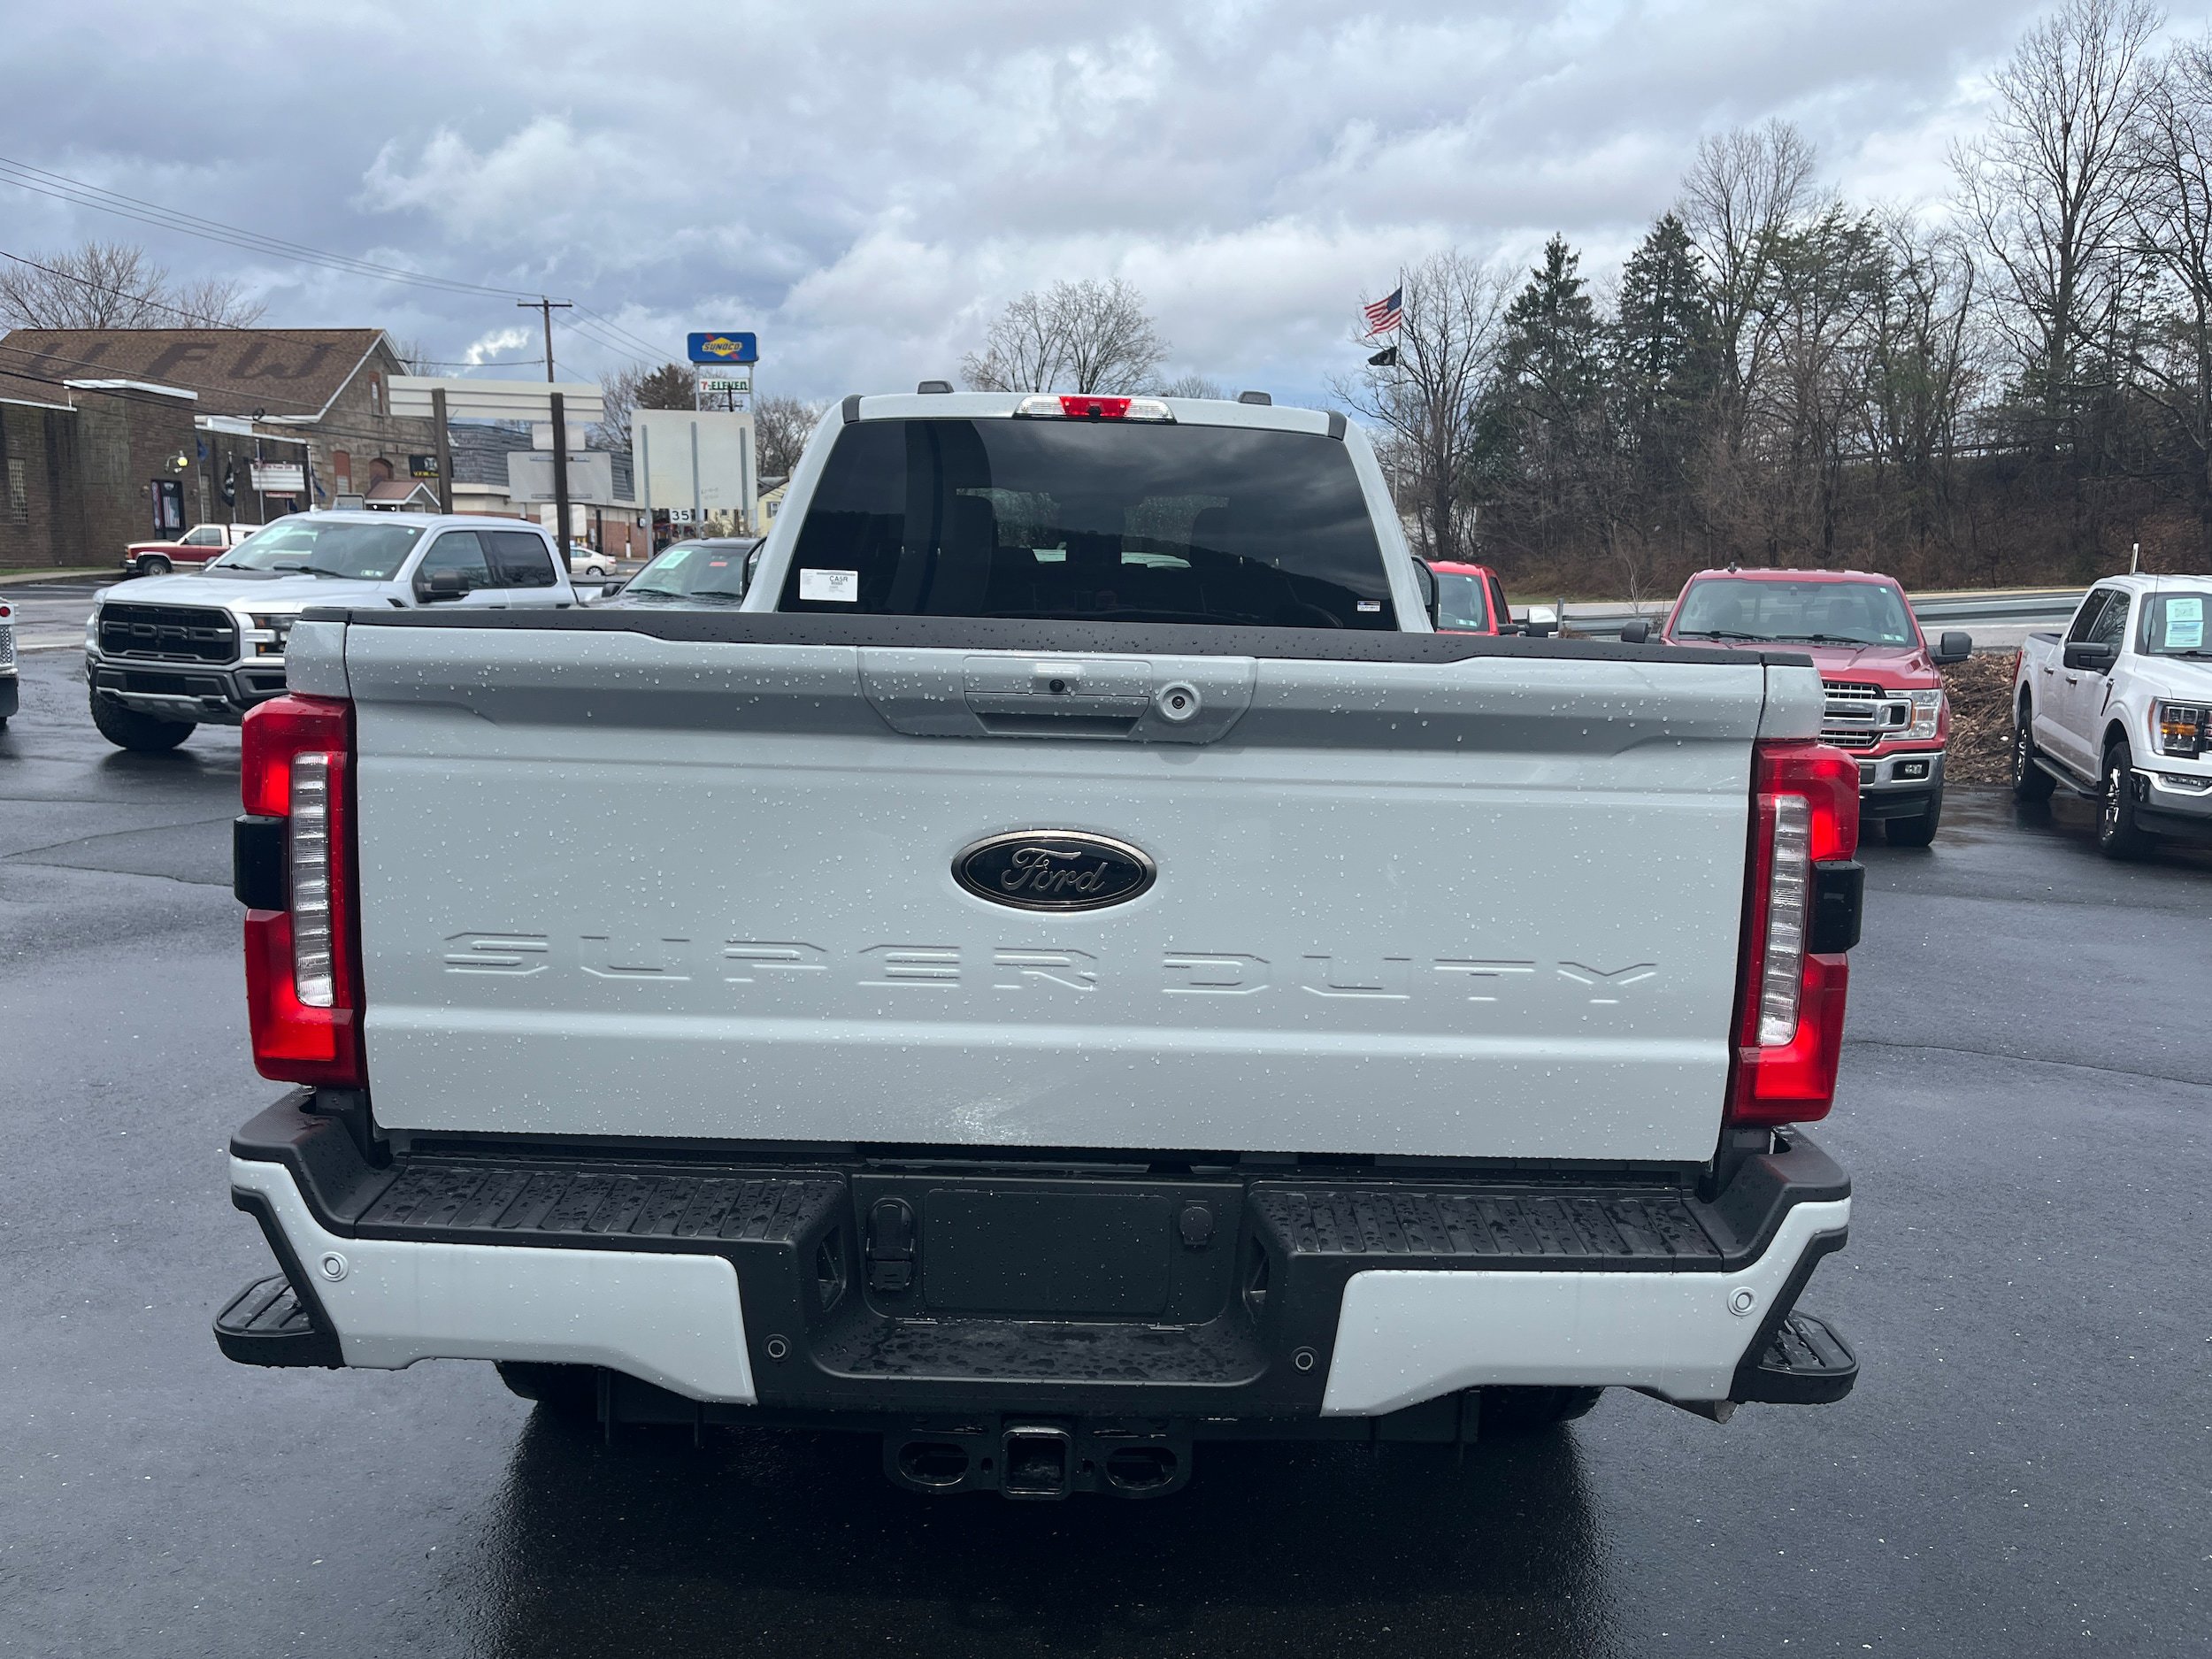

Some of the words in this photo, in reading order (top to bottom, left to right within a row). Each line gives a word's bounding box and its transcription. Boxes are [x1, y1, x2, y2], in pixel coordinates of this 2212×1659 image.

[703, 342, 741, 351] SUNOCO
[672, 510, 689, 520] 35
[102, 620, 221, 642] FORD
[1000, 847, 1109, 893] Ford
[443, 932, 1099, 991] SUPER
[1161, 950, 1658, 1005] DUTY
